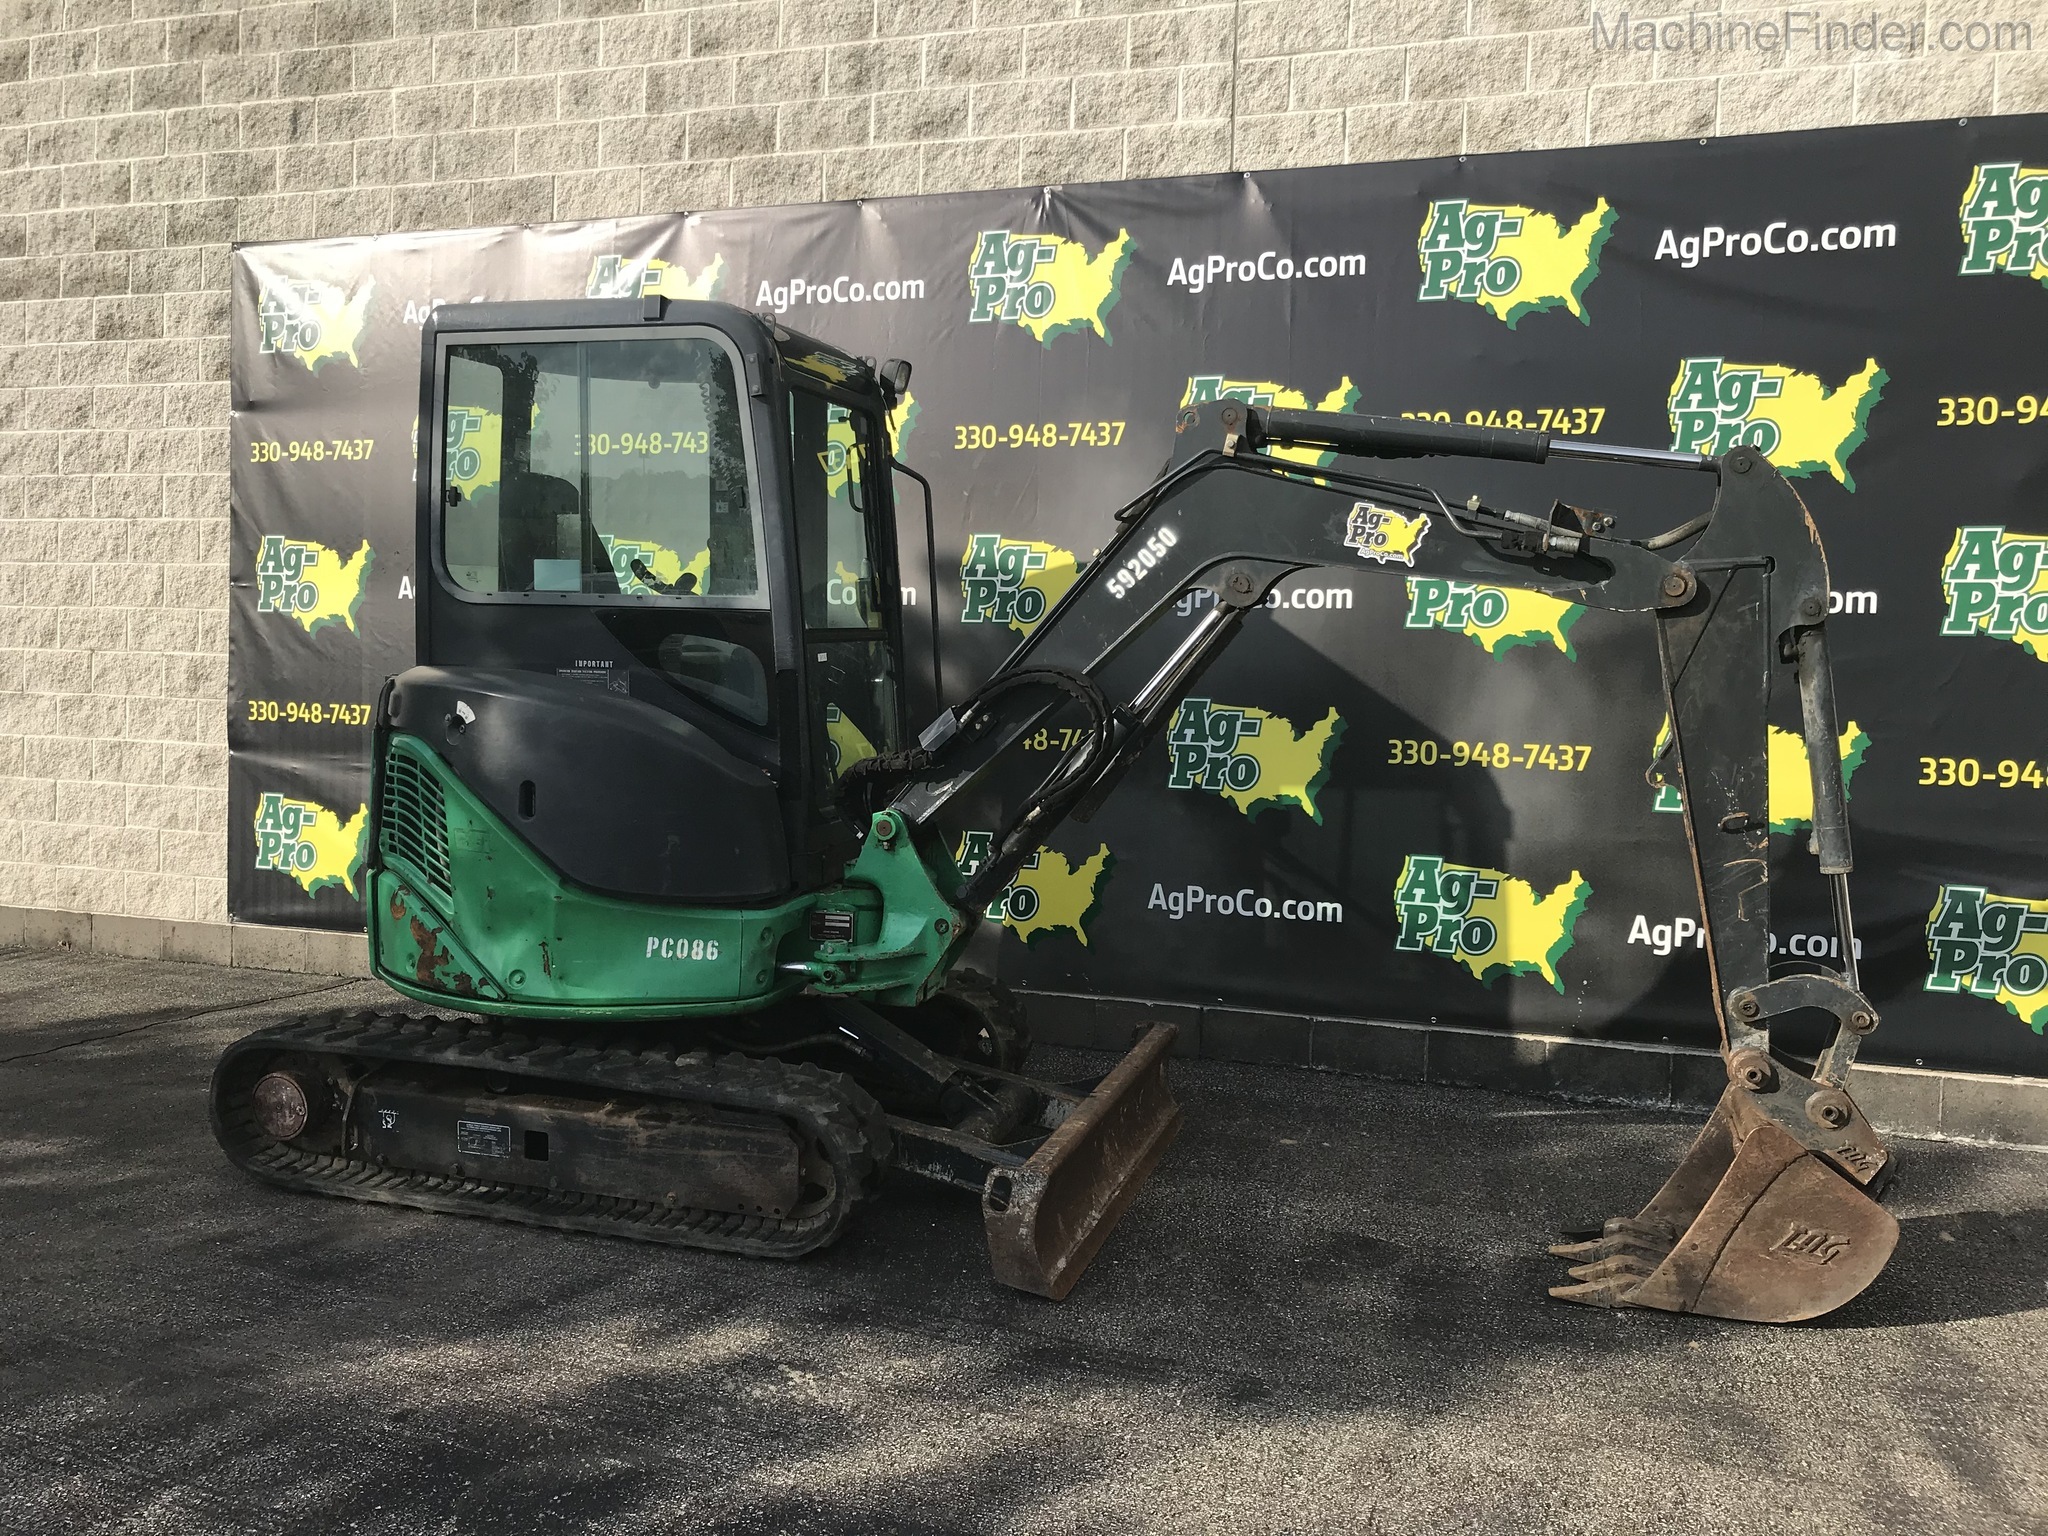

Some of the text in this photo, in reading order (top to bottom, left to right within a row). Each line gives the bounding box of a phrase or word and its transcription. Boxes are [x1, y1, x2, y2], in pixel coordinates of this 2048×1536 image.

[1421, 198, 1524, 259] Ag-
[1655, 223, 1897, 268] AgProCo.com
[1957, 217, 2048, 275] Pr
[972, 230, 1058, 280] Ag-
[1167, 252, 1366, 293] AgProCo.com
[1418, 250, 1521, 300] Pro
[756, 275, 925, 313] AgProCo.com
[969, 276, 1055, 322] Pro
[260, 313, 321, 353] Pro
[1672, 357, 1784, 420] Ag-
[250, 439, 374, 463] 330-948-7437
[954, 422, 1126, 450] 330-948-7437
[1670, 408, 1780, 456] Pro
[1346, 524, 1388, 547] Pro
[1350, 505, 1392, 531] Ag-
[258, 535, 318, 582] Ag-
[962, 533, 1046, 590] Ag-
[1106, 527, 1177, 599] 592050
[257, 573, 318, 613] Pro
[961, 577, 1046, 622] Pro
[1404, 577, 1509, 628] Pro
[575, 660, 613, 669] IMPORTANT
[248, 700, 371, 725] 330-948-7437
[1171, 698, 1262, 755] Ag-
[1168, 743, 1260, 790] Pro
[1388, 739, 1592, 772] 330-948-7437
[1919, 757, 2048, 789] 330-94
[256, 792, 317, 840] Ag-
[255, 831, 317, 870] Pro
[1149, 883, 1343, 923] AgProCo.com
[1403, 855, 1499, 917] Ag-
[1395, 903, 1497, 956] Pro
[1928, 884, 2048, 954] Ag-
[646, 936, 719, 960] PC086
[1923, 938, 2048, 996] Pro
